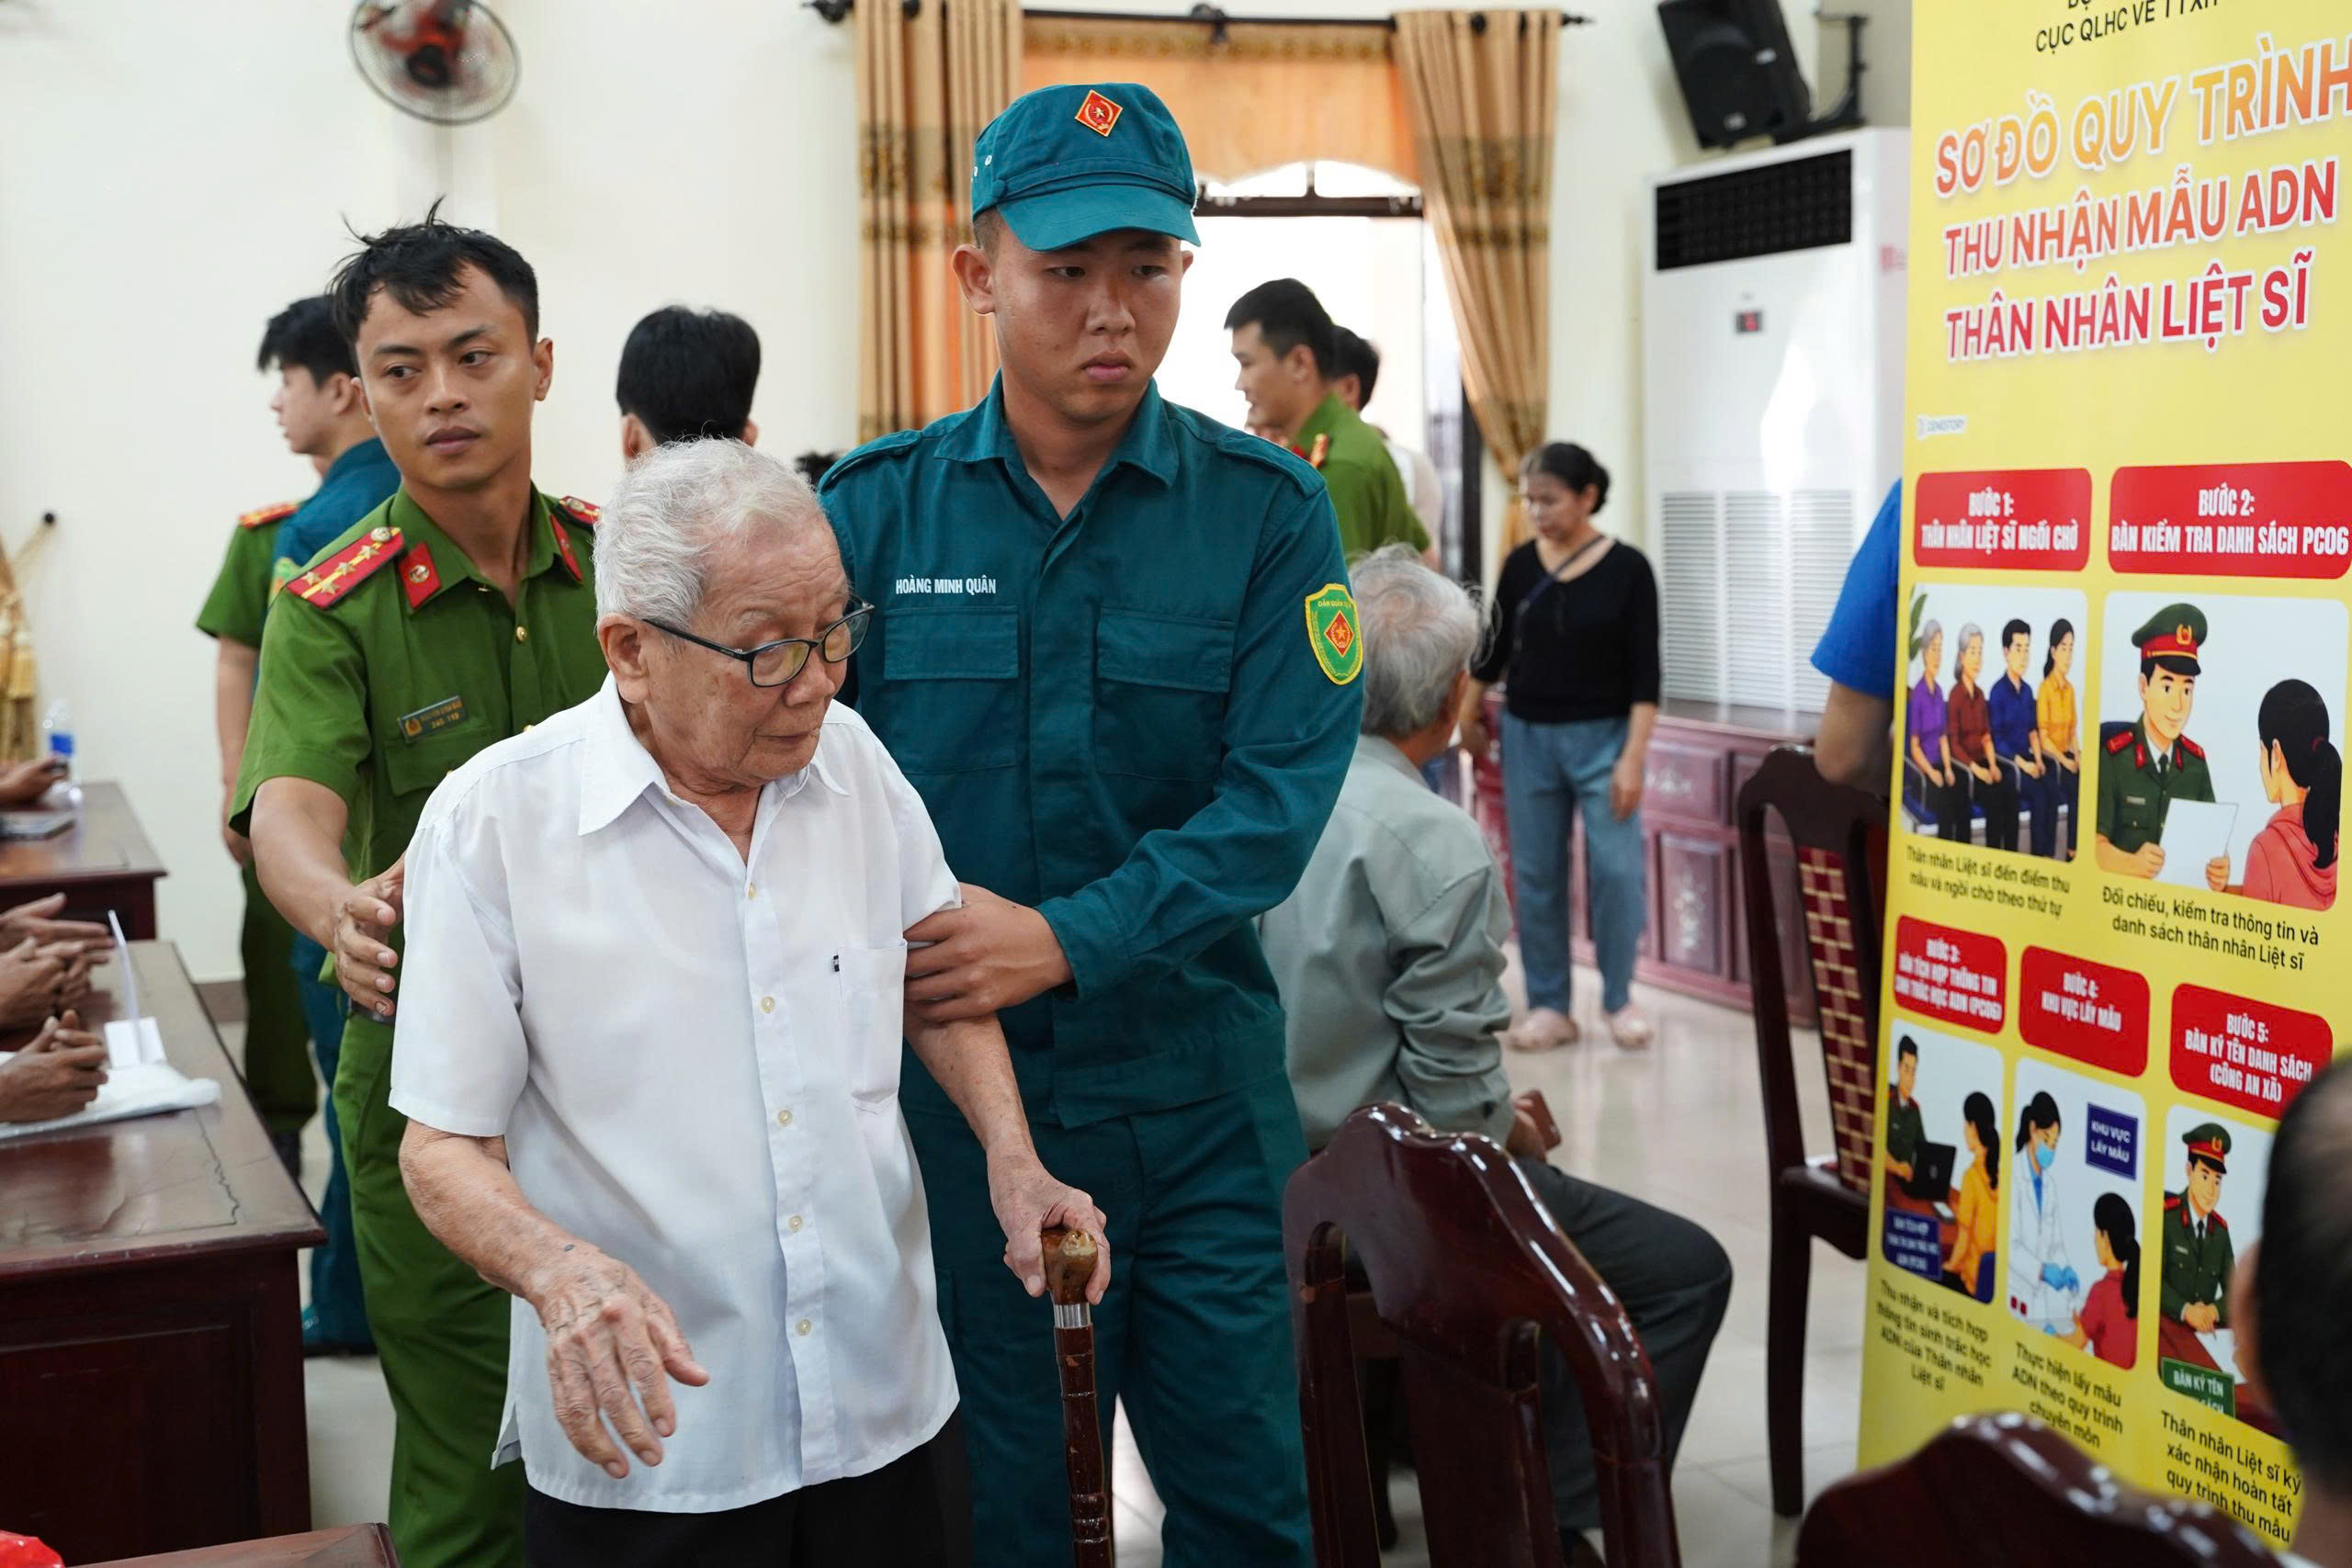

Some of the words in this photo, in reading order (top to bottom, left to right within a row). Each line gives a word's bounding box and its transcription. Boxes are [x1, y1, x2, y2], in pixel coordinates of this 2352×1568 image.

[2036, 23, 2074, 54] CỤC
[2080, 7, 2128, 41] QLHC
[1936, 120, 1990, 195] SƠ
[1995, 92, 2059, 182] ĐỒ
[2073, 79, 2177, 168] QUY
[2192, 35, 2352, 141] TRÌNH
[1945, 219, 2004, 275] THU
[2012, 190, 2118, 270] NHẬN
[2126, 166, 2228, 248] MẪU
[2236, 161, 2335, 233] ADN
[1947, 291, 2033, 358] THÂN
[2044, 276, 2150, 349] NHÂN
[2162, 263, 2254, 349] LIỆT
[2262, 251, 2313, 328] SĨ
[2198, 482, 2237, 516] BƯỚC
[2239, 489, 2255, 517] 2:
[1974, 519, 2000, 554] LIỆT
[2001, 519, 2018, 549] SĨ
[2052, 518, 2078, 550] CHỜ
[2110, 519, 2138, 552] BÀN
[2141, 518, 2181, 553] KIỂM
[2185, 525, 2212, 553] TRA
[2216, 525, 2255, 554] DANH
[2258, 520, 2298, 555] SÁCH
[2302, 526, 2349, 555] PC06
[895, 574, 932, 594] HOÀNG
[934, 578, 963, 594] MINH
[966, 574, 997, 595] QUÂN
[1996, 889, 2025, 908] theo
[2052, 875, 2070, 893] thu
[2112, 915, 2146, 936] danh
[2150, 921, 2184, 944] sách
[2188, 930, 2219, 952] thân
[2222, 938, 2256, 960] nhân
[2259, 944, 2286, 970] Liệt
[2290, 952, 2305, 971] sĩ
[2211, 908, 2230, 927] tra
[2233, 912, 2272, 941] thông
[2276, 920, 2295, 942] tin
[2300, 926, 2319, 945] và
[2226, 1012, 2256, 1040] BƯỚC
[2256, 1021, 2269, 1043] 5:
[2184, 1027, 2207, 1054] BÀN
[2210, 1033, 2224, 1058] KÝ
[2226, 1036, 2246, 1066] TÊN
[2247, 1046, 2278, 1075] DANH
[2279, 1054, 2312, 1082] SÁCH
[2210, 1061, 2244, 1091] (CÔNG
[2245, 1073, 2260, 1097] AN
[2040, 1379, 2065, 1405] theo
[2067, 1396, 2090, 1421] quy
[2161, 1410, 2196, 1441] Thân
[2199, 1431, 2233, 1461] nhân
[2236, 1447, 2263, 1476] Liệt
[2266, 1463, 2279, 1483] sĩ
[2283, 1468, 2301, 1495] ký
[2166, 1469, 2193, 1495] quy
[2197, 1482, 2229, 1511] trình
[2231, 1498, 2256, 1525] thu
[2167, 1442, 2191, 1466] xác
[2195, 1455, 2229, 1485] nhận
[2233, 1472, 2268, 1506] hoàn
[2271, 1492, 2293, 1517] tất
